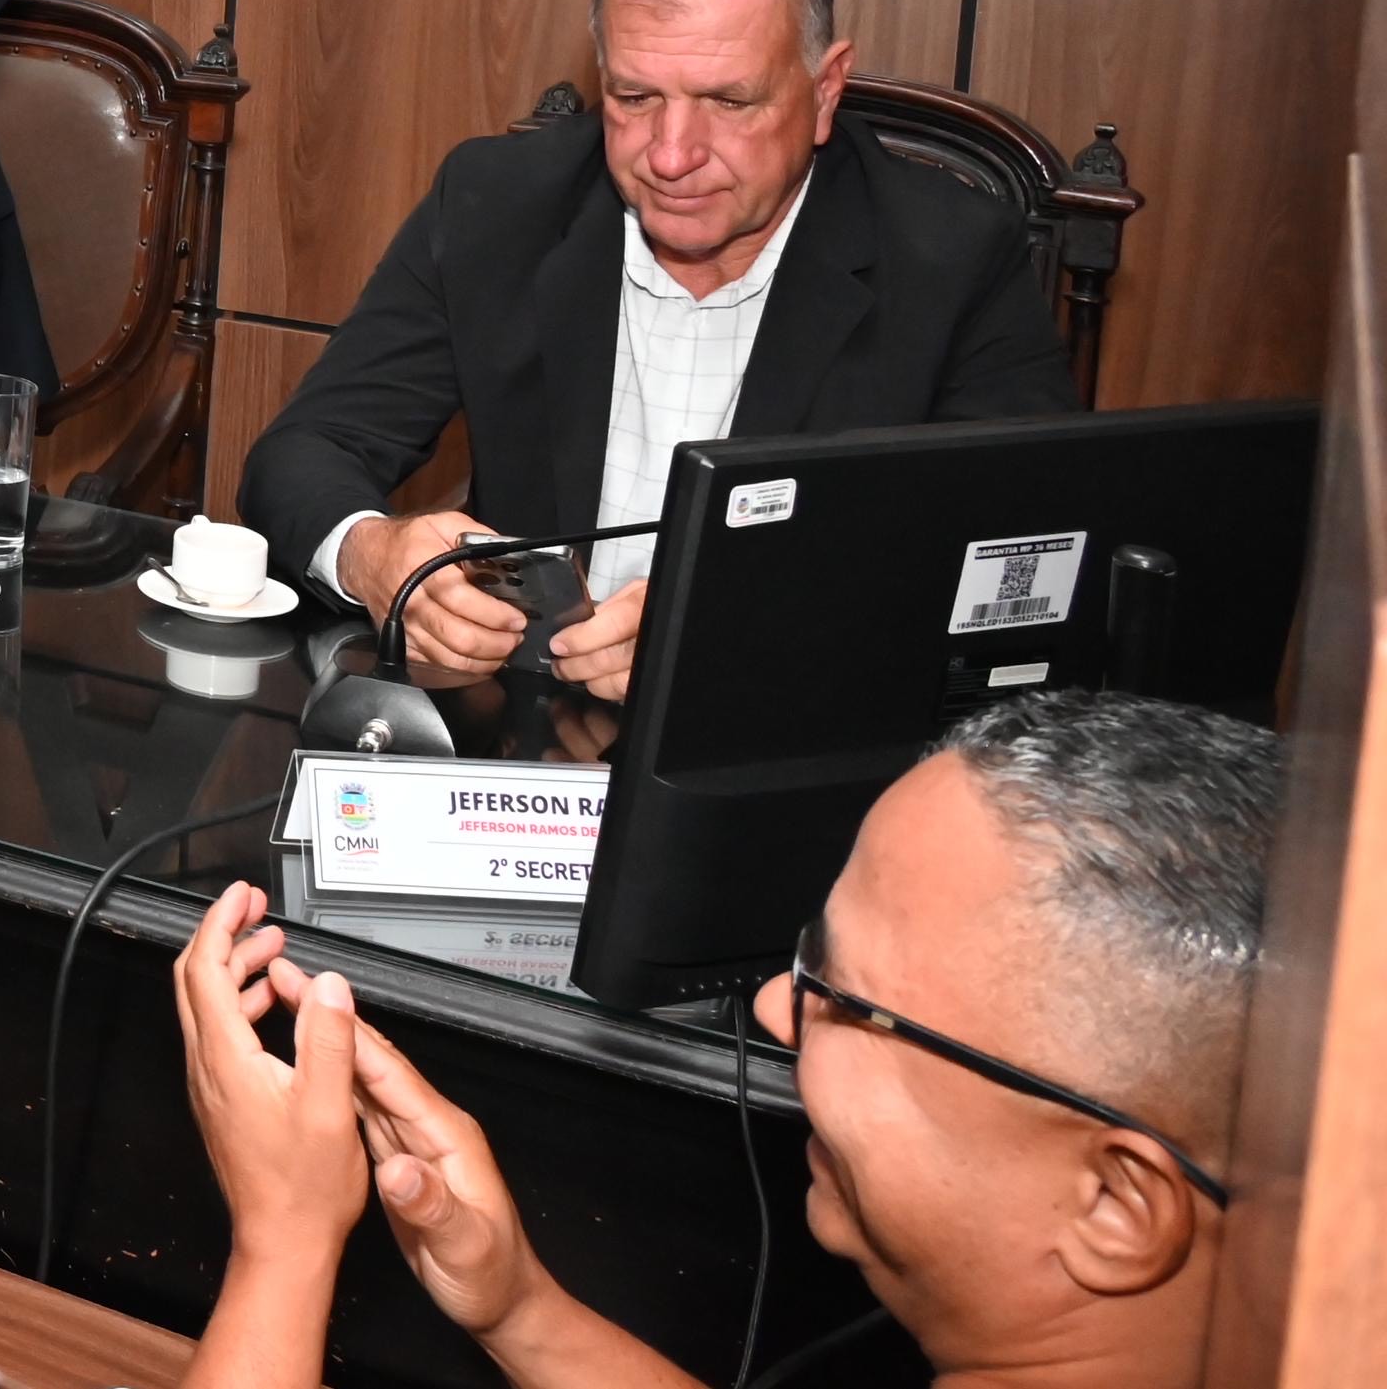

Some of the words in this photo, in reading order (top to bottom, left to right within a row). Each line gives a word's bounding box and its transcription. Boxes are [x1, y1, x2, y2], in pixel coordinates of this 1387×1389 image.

[448, 791, 569, 815] JEFERSON
[459, 821, 527, 834] JEFERSON
[529, 824, 578, 837] RAMOS
[334, 835, 379, 852] CMNI
[514, 861, 592, 881] SECRET
